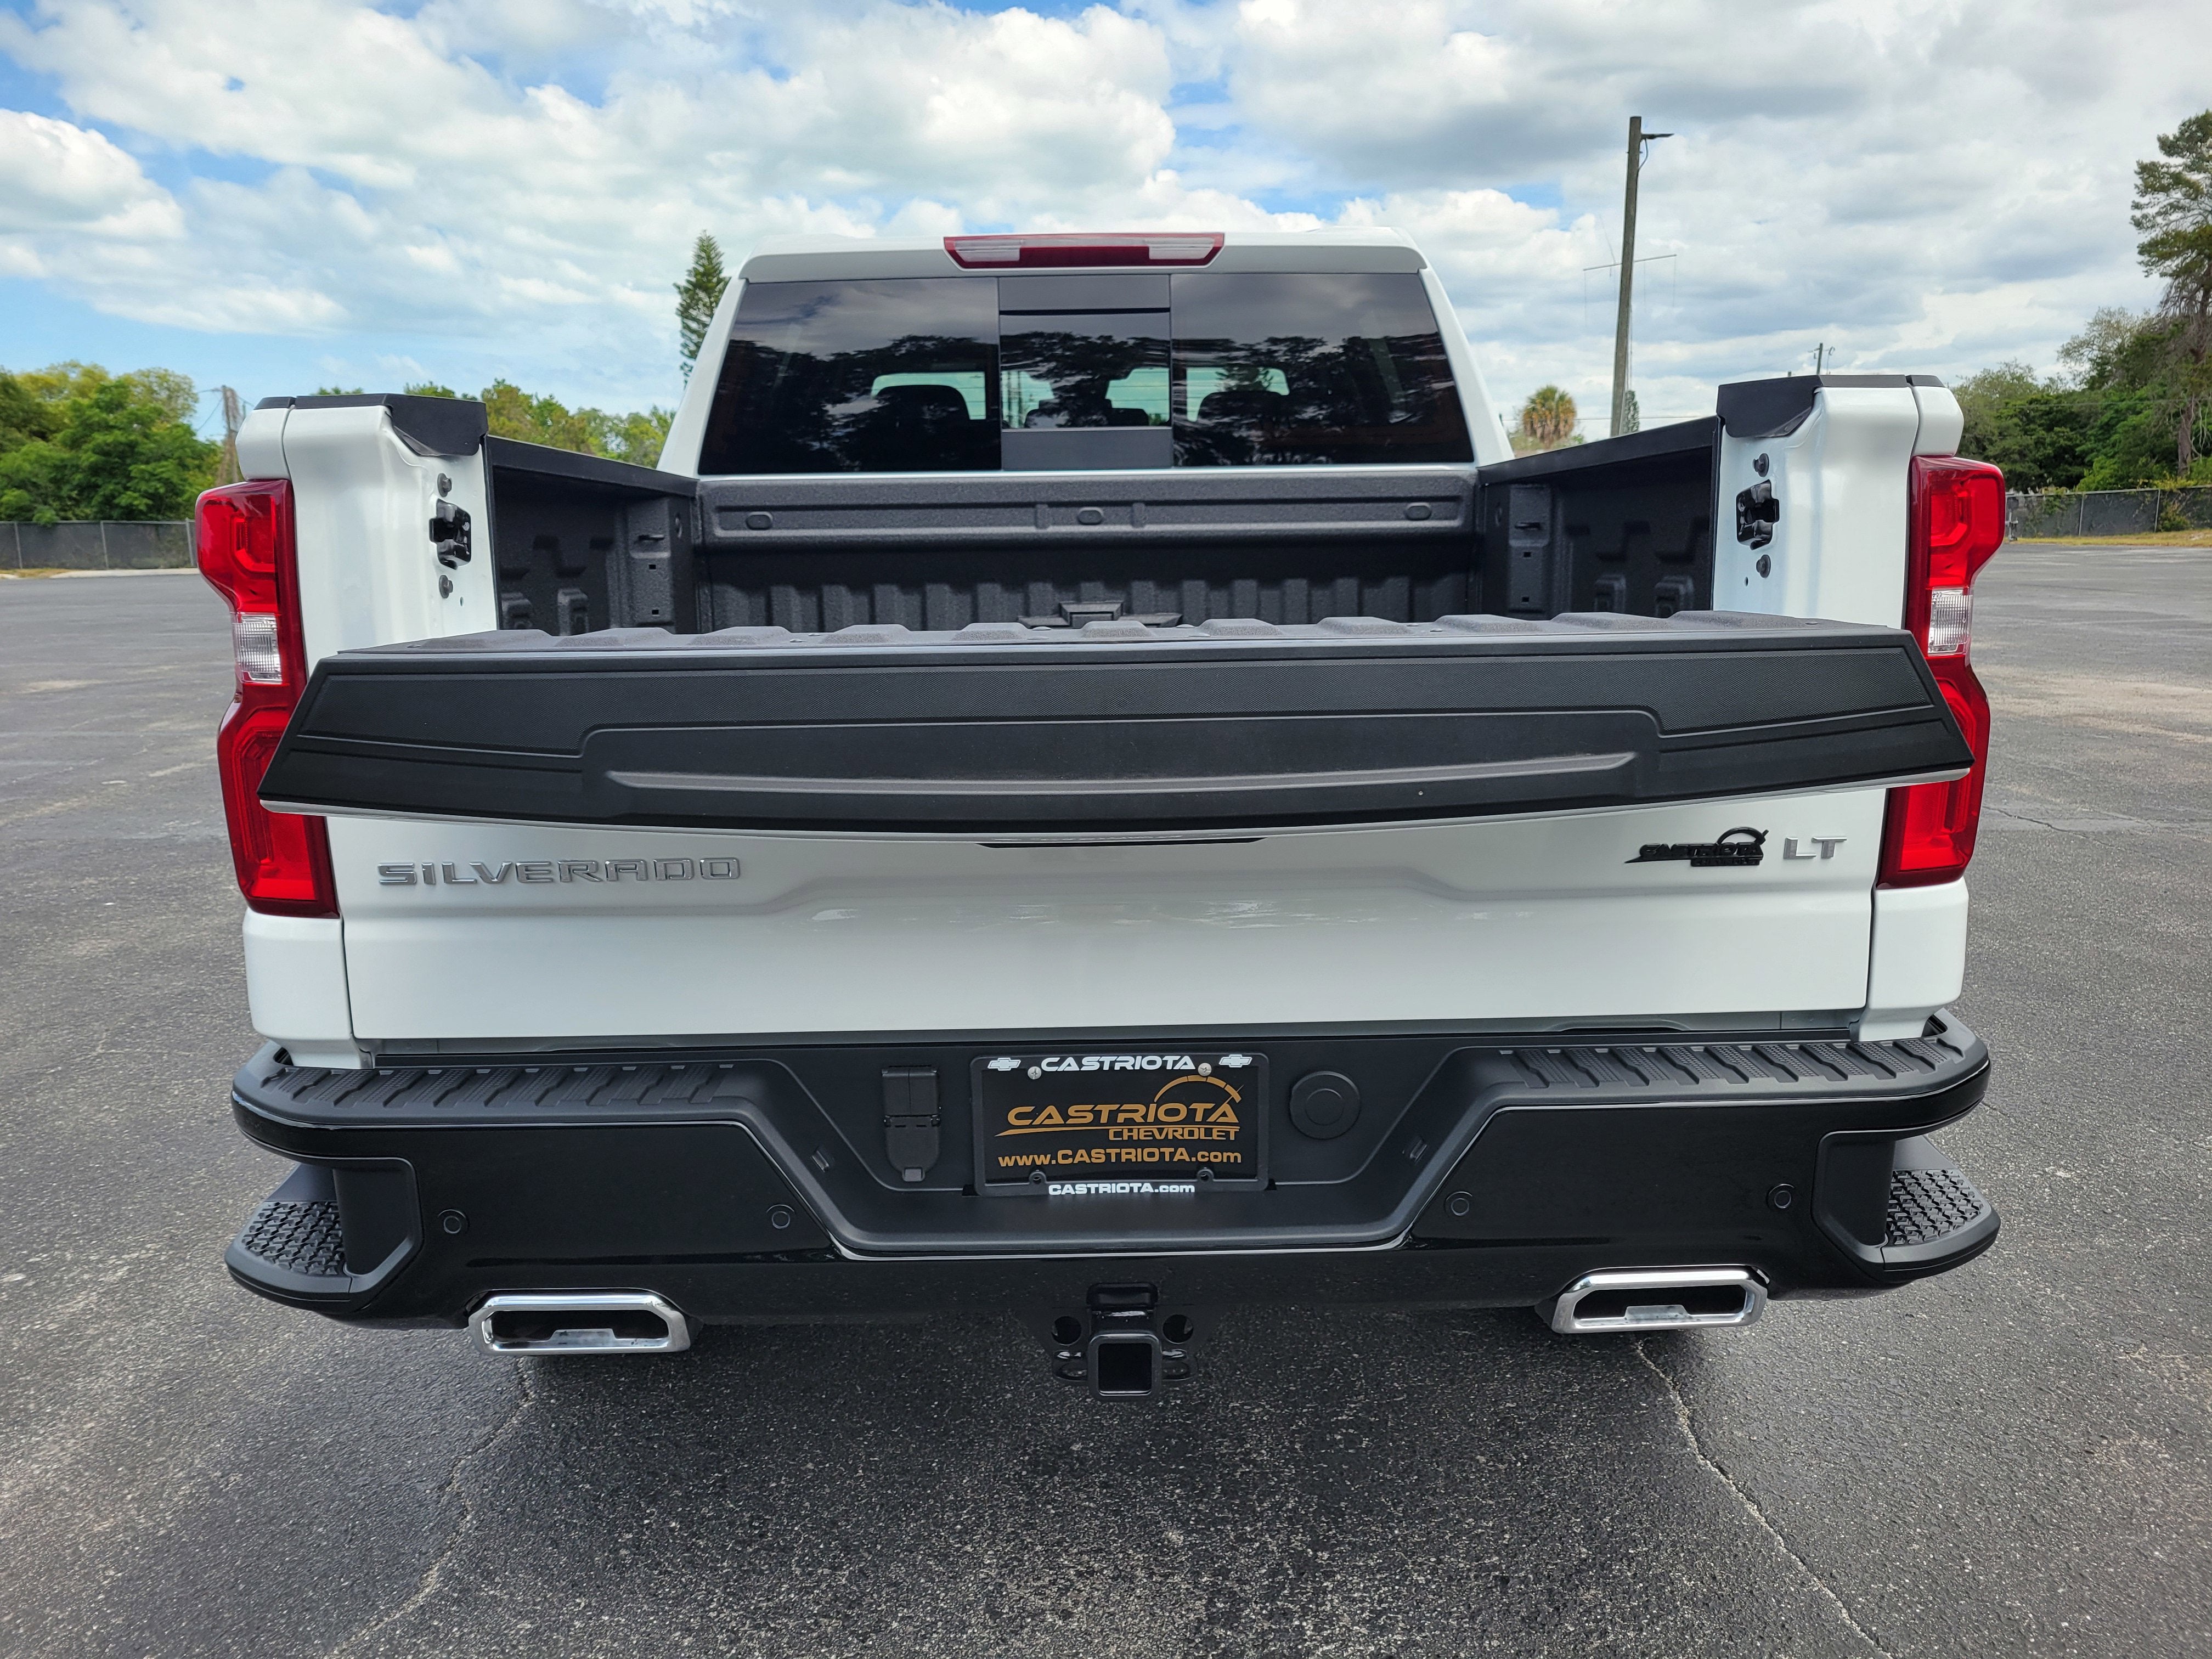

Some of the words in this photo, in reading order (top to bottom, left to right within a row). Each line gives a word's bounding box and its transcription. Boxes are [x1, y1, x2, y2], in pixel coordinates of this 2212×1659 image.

[1783, 837, 1847, 860] LT
[377, 857, 741, 885] SILVERADO
[1041, 1056, 1195, 1071] CASTRIOTA
[1007, 1103, 1239, 1125] CASTRIOTA
[1109, 1128, 1237, 1141] CHEVROLET
[997, 1147, 1242, 1167] www.CASTRIOTA.com
[1048, 1183, 1195, 1195] CASTRIOTA.com
